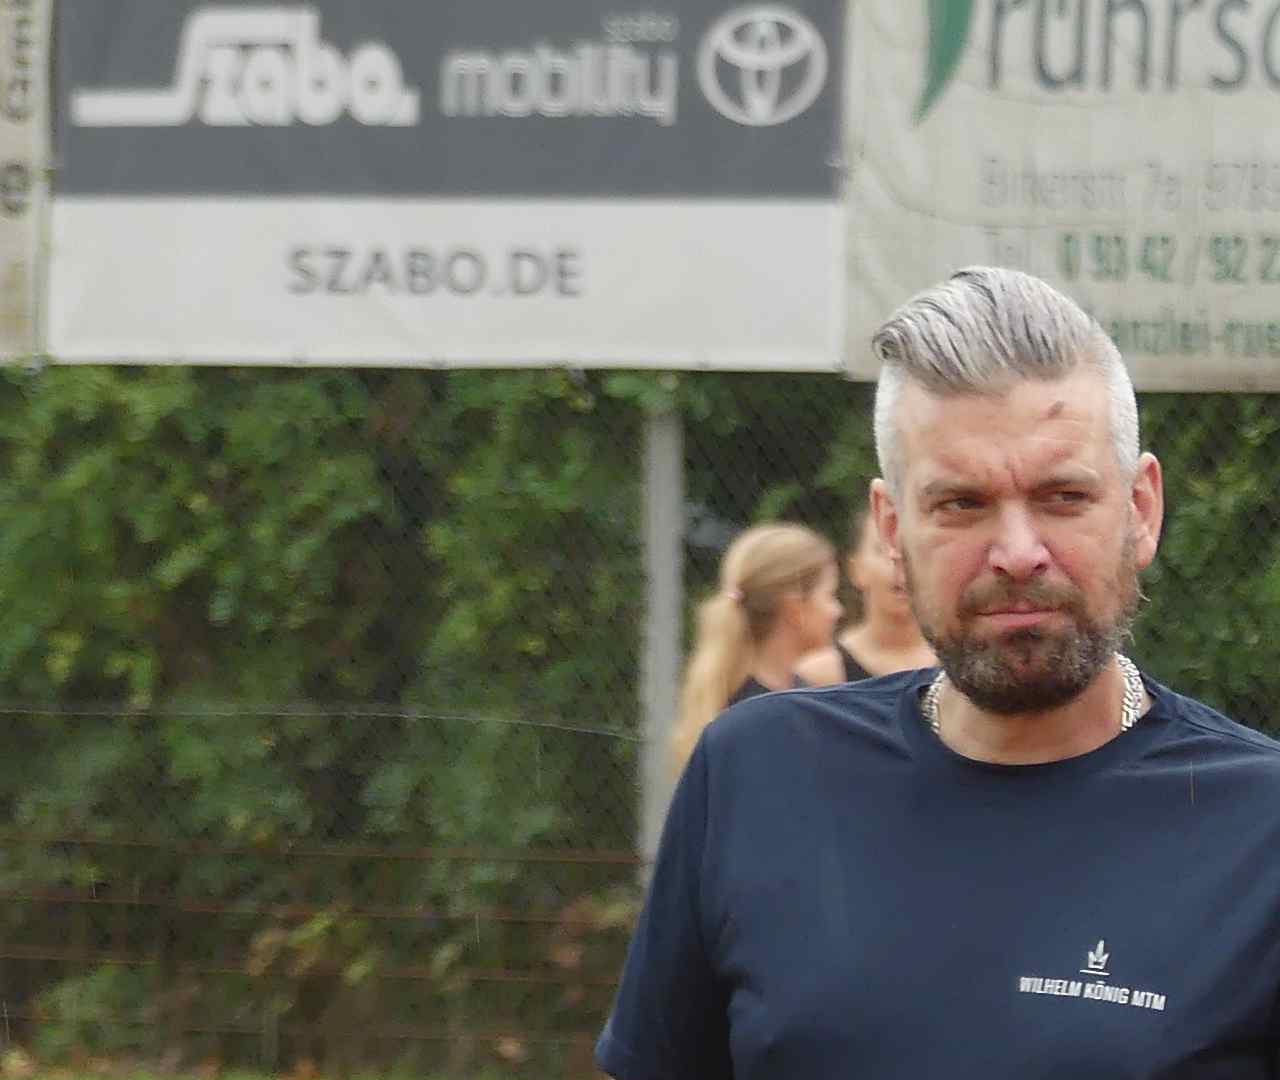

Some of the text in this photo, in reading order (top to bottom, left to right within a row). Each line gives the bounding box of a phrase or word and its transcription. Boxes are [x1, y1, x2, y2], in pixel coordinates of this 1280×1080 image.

[440, 41, 677, 127] mobility
[287, 246, 586, 297] SZABO.DE
[1019, 976, 1167, 1011] WILHELM KÖNIG MTM
